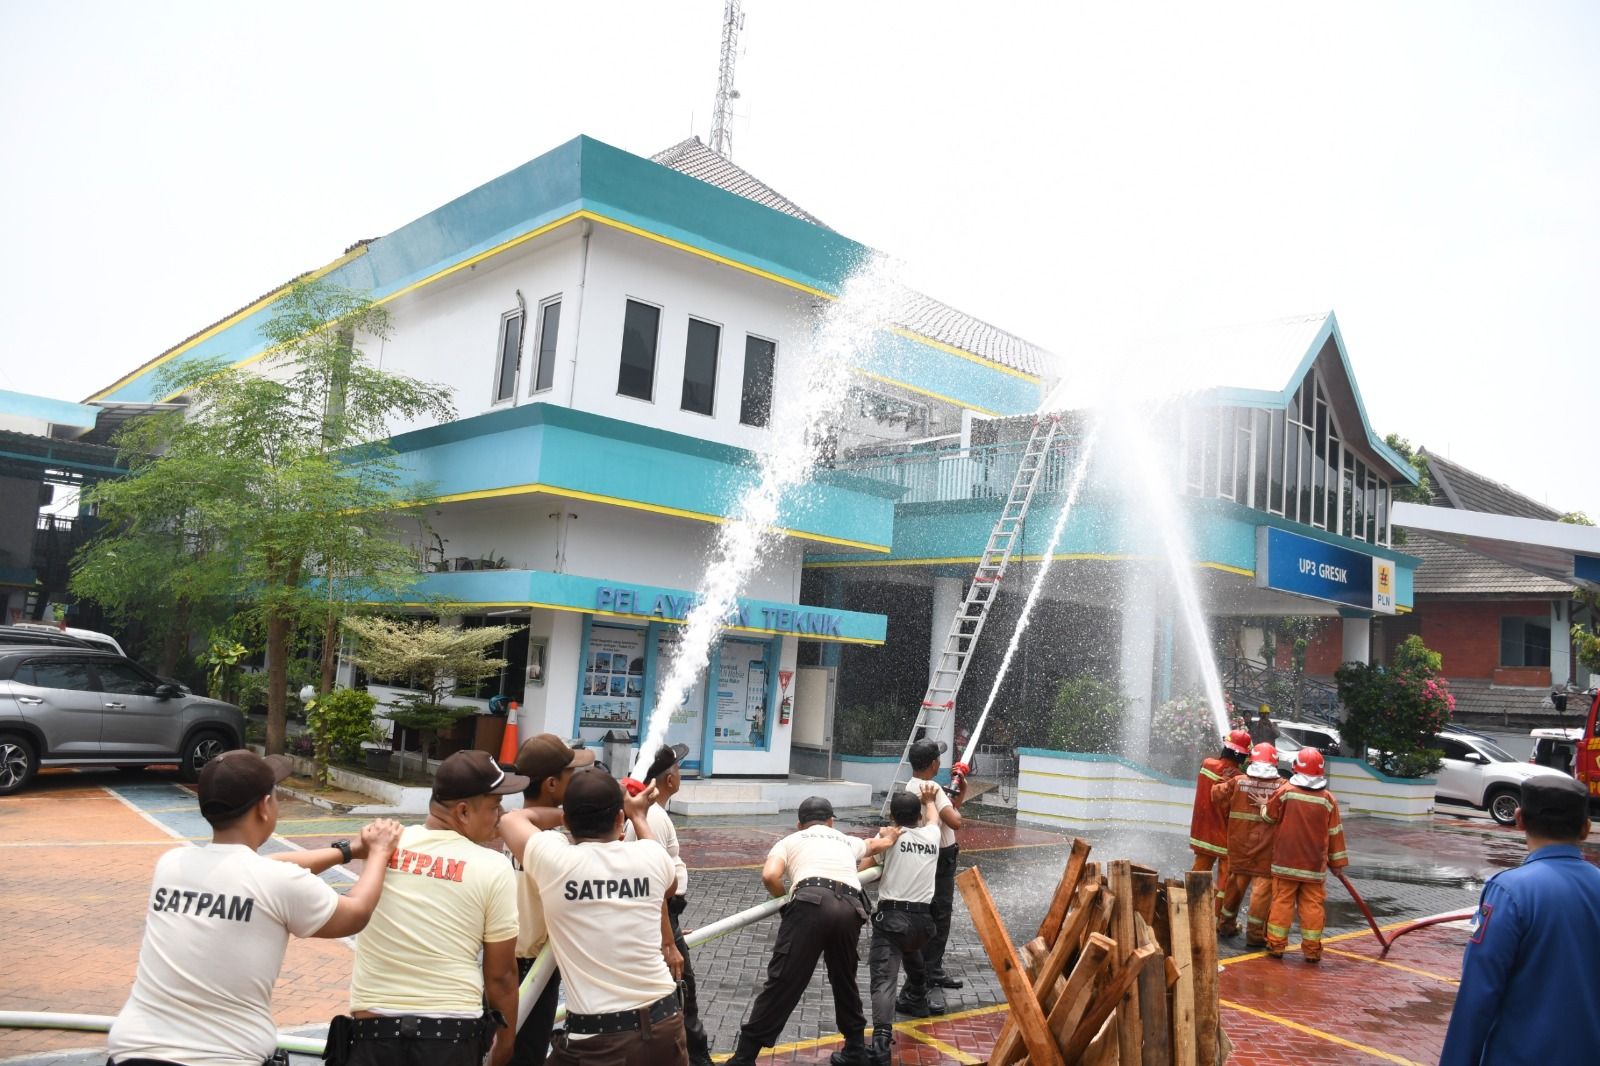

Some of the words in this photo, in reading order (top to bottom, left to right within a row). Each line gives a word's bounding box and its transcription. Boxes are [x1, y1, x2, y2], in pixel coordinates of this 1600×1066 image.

[1299, 558, 1317, 576] UP3
[1318, 563, 1348, 584] GRESIK
[1377, 594, 1391, 607] PLN
[762, 606, 843, 637] TEKNIK
[386, 847, 466, 883] ATPAM
[565, 877, 650, 900] SATPAM
[153, 887, 254, 922] SATPAM
